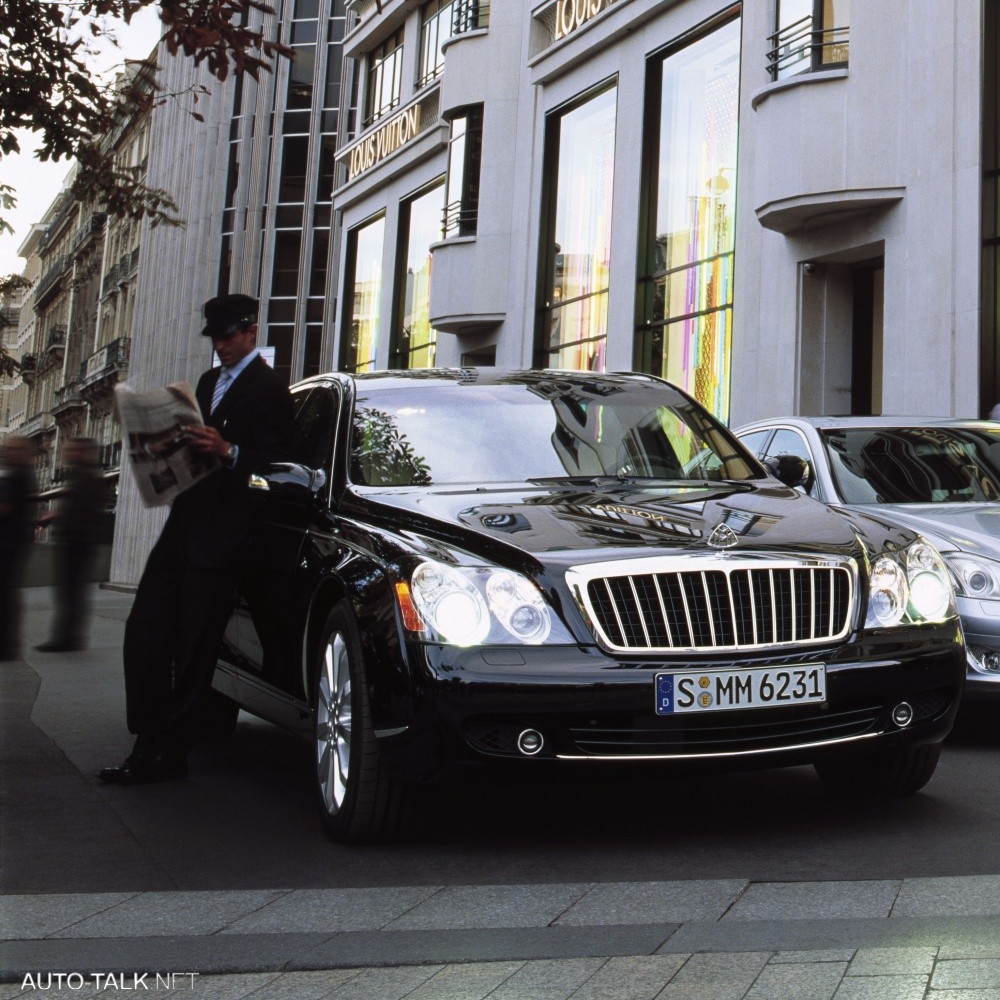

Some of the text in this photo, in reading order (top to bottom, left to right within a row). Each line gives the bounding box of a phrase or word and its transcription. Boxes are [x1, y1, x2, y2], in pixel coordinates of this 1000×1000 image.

[349, 104, 421, 181] LOUIS VUITTON
[663, 669, 823, 708] D S MM 6231
